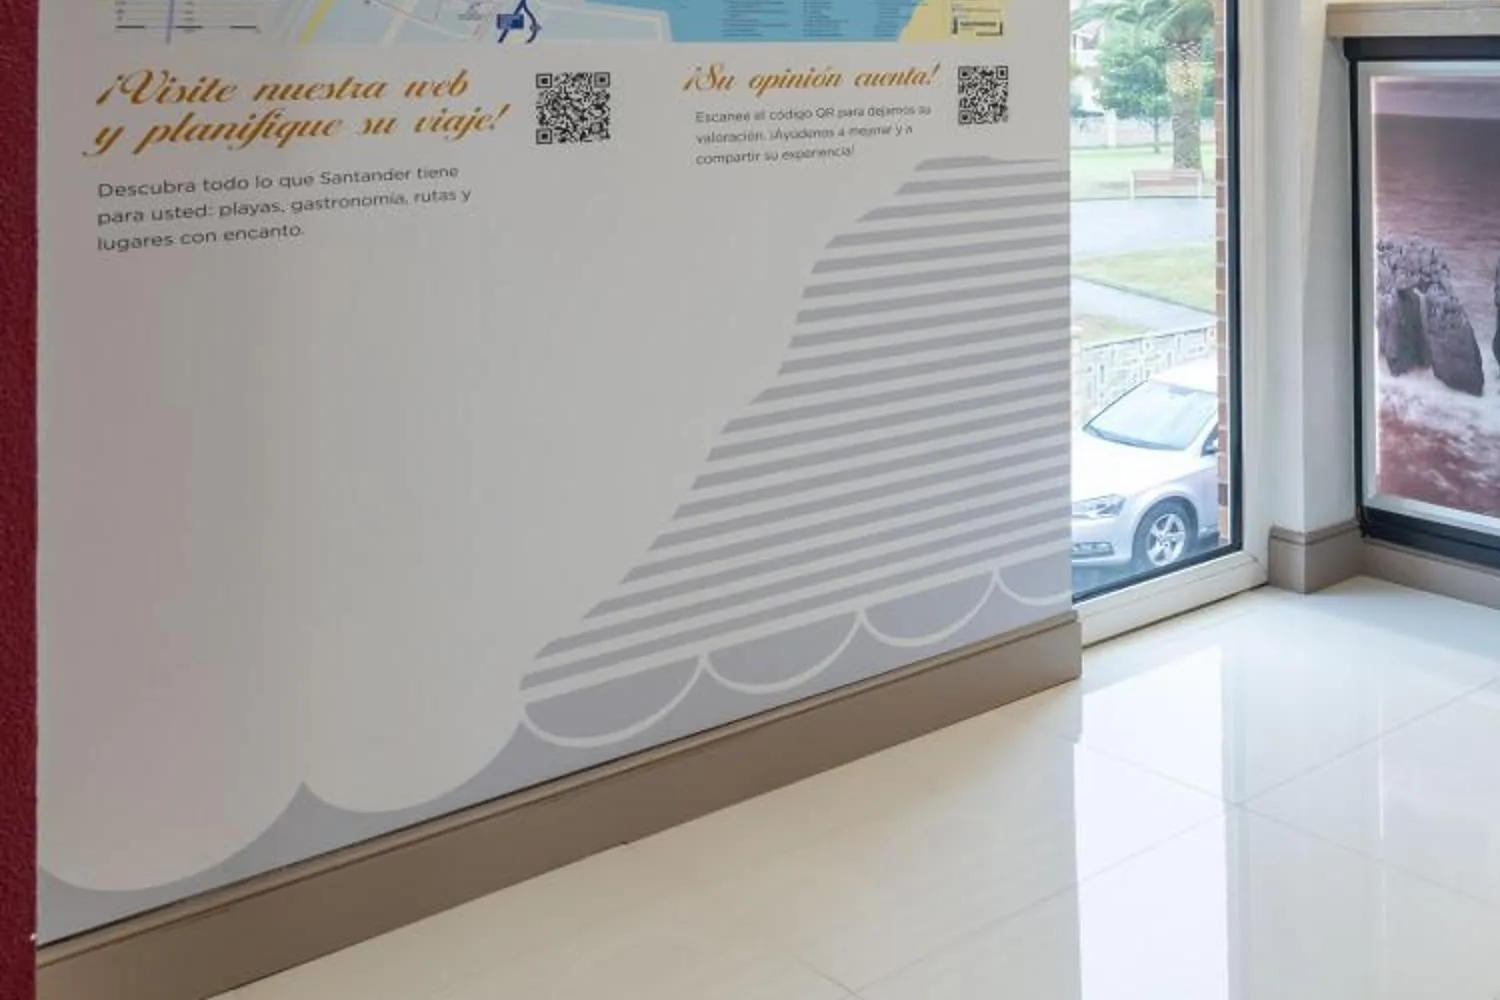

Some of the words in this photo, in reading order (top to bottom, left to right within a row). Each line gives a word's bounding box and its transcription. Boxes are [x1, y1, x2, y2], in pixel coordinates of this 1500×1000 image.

[96, 69, 238, 105] ¡Visite
[253, 76, 388, 102] nuestra
[404, 69, 469, 98] web
[682, 63, 736, 93] ¡Su
[747, 65, 843, 96] opinión
[854, 63, 941, 87] cuenta!
[82, 125, 125, 157] y
[132, 107, 343, 155] planifique
[358, 116, 398, 135] su
[413, 103, 511, 141] viaje!
[695, 110, 751, 124] Escanee
[754, 109, 766, 122] el
[769, 107, 814, 122] código
[816, 106, 835, 119] QR
[837, 105, 866, 121] para
[918, 104, 932, 116] su
[904, 121, 914, 134] a
[695, 152, 761, 167] compartir
[764, 149, 780, 161] su
[781, 144, 856, 164] experiencia!
[97, 179, 197, 198] Descubra
[202, 176, 250, 193] todo
[255, 175, 274, 189] lo
[279, 174, 315, 189] que
[319, 168, 412, 186] Santander
[416, 165, 460, 180] tiene
[97, 209, 146, 227] para
[150, 203, 214, 222] usted:
[413, 187, 457, 203] rutas
[461, 189, 473, 201] y
[97, 235, 175, 253] lugares
[179, 231, 218, 246] con
[223, 223, 306, 242] encanto.
